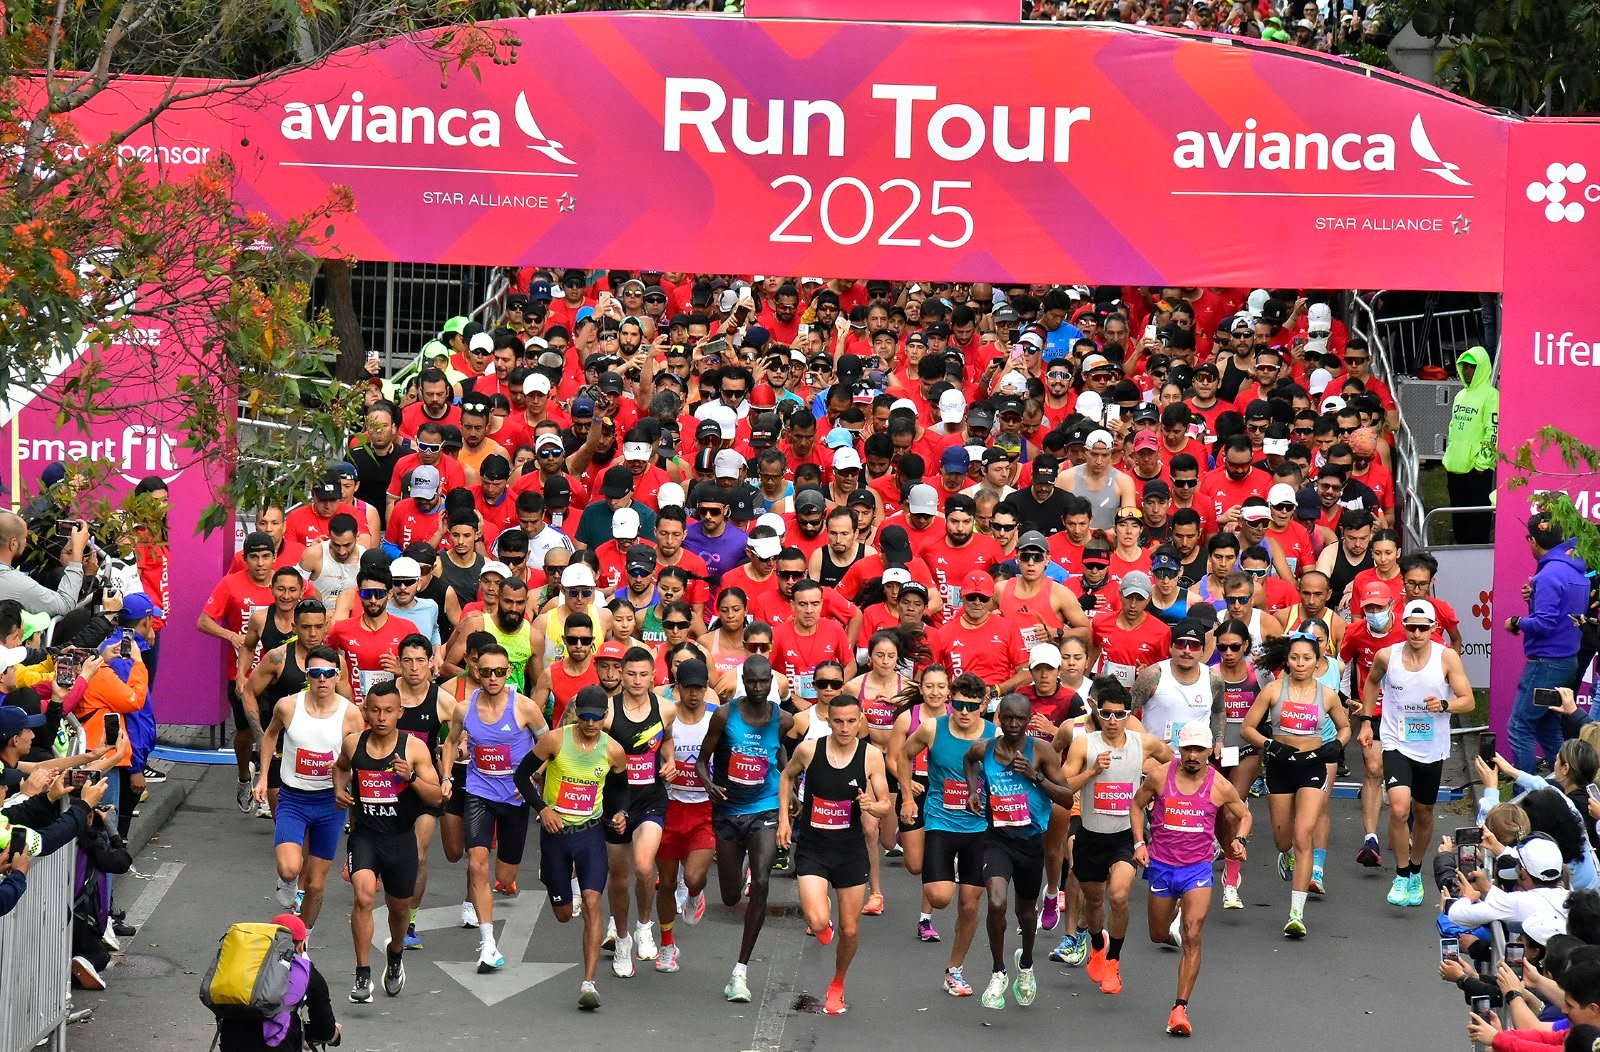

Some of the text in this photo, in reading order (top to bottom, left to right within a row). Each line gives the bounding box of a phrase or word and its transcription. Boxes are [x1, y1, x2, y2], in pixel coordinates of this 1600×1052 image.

[280, 90, 501, 148] avianca
[663, 77, 1091, 163] Run Tour
[1173, 117, 1396, 172] avianca
[55, 142, 210, 167] copensar
[423, 191, 548, 209] STAR ALLIANCE
[769, 174, 974, 248] 2025
[1315, 217, 1443, 231] STAR ALLIANCE
[1453, 404, 1479, 415] OPEN
[18, 424, 178, 471] smart fit
[1281, 710, 1318, 722] SANDRA
[1408, 723, 1431, 731] 17055
[480, 754, 504, 763] JOHN
[735, 762, 761, 772] TITUS
[361, 779, 393, 789] OSCAR
[685, 779, 695, 787] 20
[372, 790, 382, 798] 15
[564, 791, 592, 802] KEVIN
[1094, 792, 1133, 801] JEISSON
[813, 806, 849, 817] MIGUEL
[992, 802, 1028, 813] JOSEPH
[1165, 807, 1205, 817] FRANKLIN
